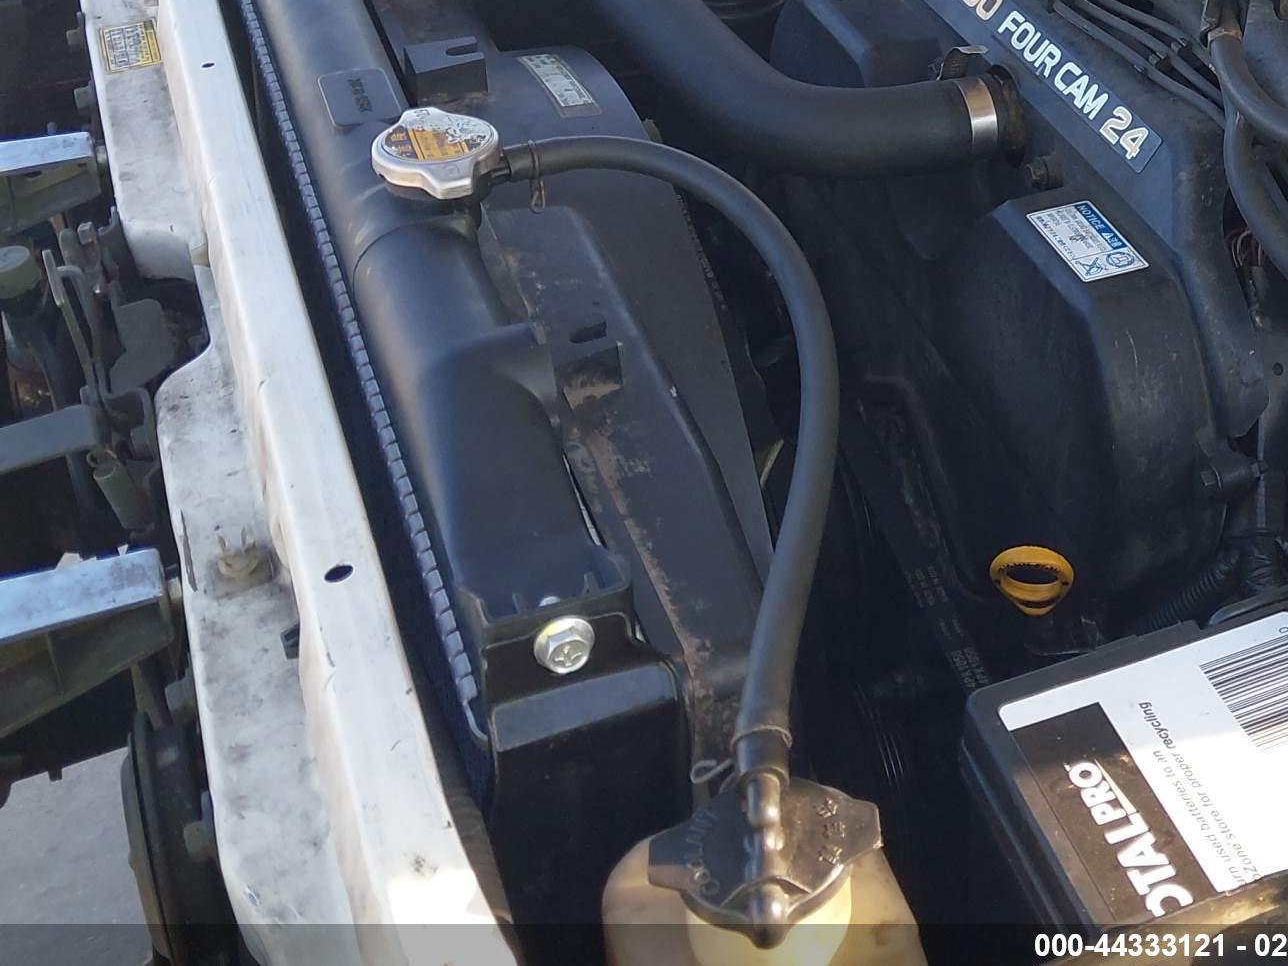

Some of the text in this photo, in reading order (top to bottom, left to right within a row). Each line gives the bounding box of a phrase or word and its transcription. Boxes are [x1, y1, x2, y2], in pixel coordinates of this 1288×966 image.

[997, 10, 1061, 77] FOUR
[1054, 62, 1108, 120] CAM
[1099, 106, 1149, 159] 24
[1138, 701, 1177, 750] recycling
[1152, 749, 1169, 764] an
[1163, 765, 1176, 779] to
[1172, 751, 1202, 790] proper
[1172, 779, 1211, 832] batteries
[1197, 790, 1214, 809] for
[1209, 810, 1236, 842] store
[1206, 834, 1232, 864] used
